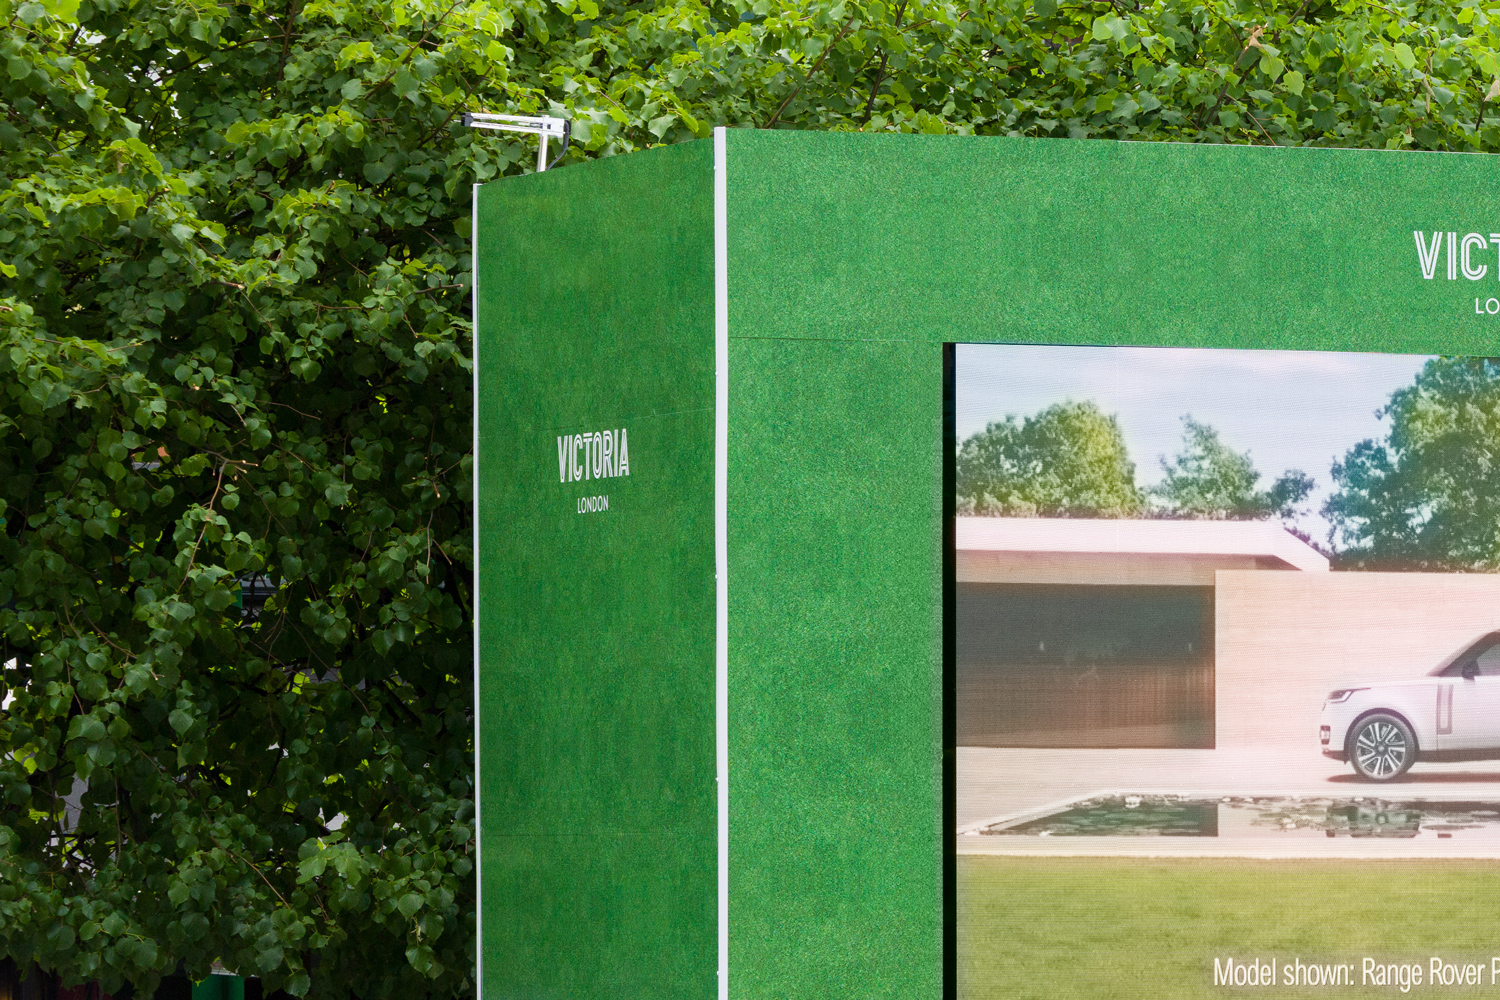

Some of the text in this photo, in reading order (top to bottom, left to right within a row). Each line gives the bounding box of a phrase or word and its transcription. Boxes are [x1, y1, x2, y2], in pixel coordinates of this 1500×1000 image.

[557, 428, 630, 483] VICTORIA
[577, 494, 609, 514] LONDON
[1213, 957, 1277, 987] Model
[1282, 957, 1356, 987] shown:
[1362, 957, 1423, 993] Range
[1429, 957, 1487, 986] Rover
